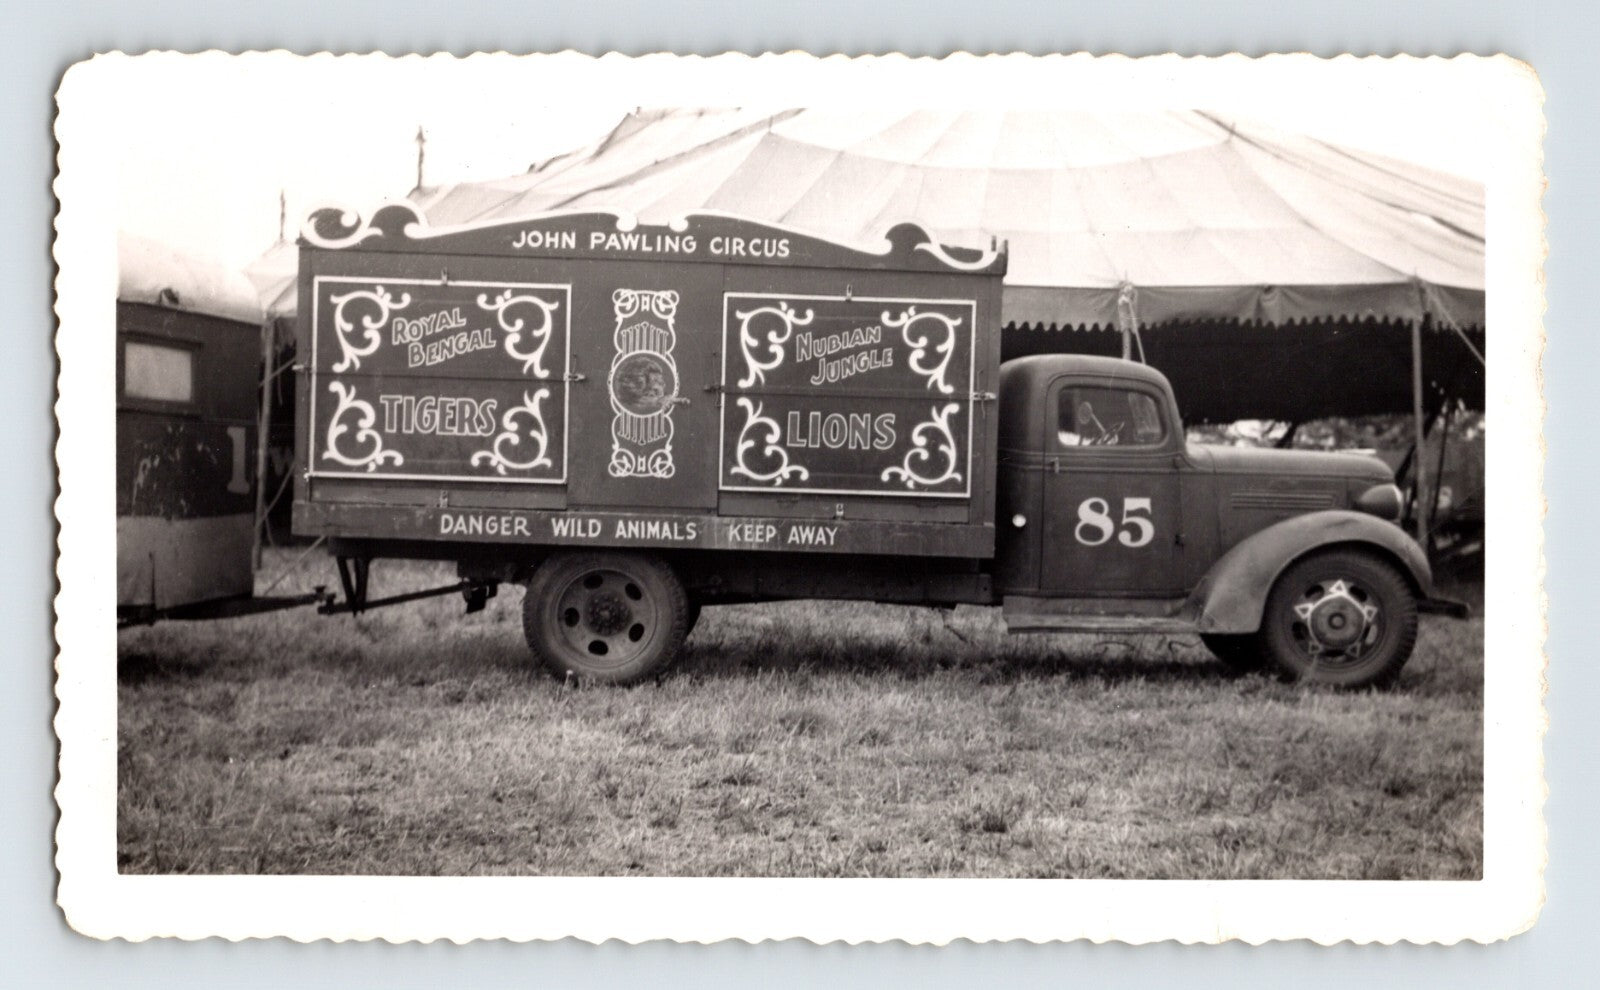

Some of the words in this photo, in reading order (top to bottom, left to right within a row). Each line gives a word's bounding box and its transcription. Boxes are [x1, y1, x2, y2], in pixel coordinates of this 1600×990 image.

[513, 231, 576, 249] JOHN
[591, 233, 697, 253] PAWLING
[710, 237, 790, 257] CIRCUS
[392, 308, 467, 345] ROYAL
[796, 326, 881, 362] NUBIAN
[408, 328, 496, 368] BENGAL
[810, 348, 893, 385] JUNGLE
[380, 395, 498, 437] TIGERS
[787, 411, 897, 450] LIONS
[440, 515, 531, 537] DANGER
[551, 518, 602, 539] WILD
[615, 520, 698, 541] ANIMALS
[728, 524, 777, 543] KEEP
[788, 526, 839, 547] AWAY
[1075, 497, 1154, 548] 85
